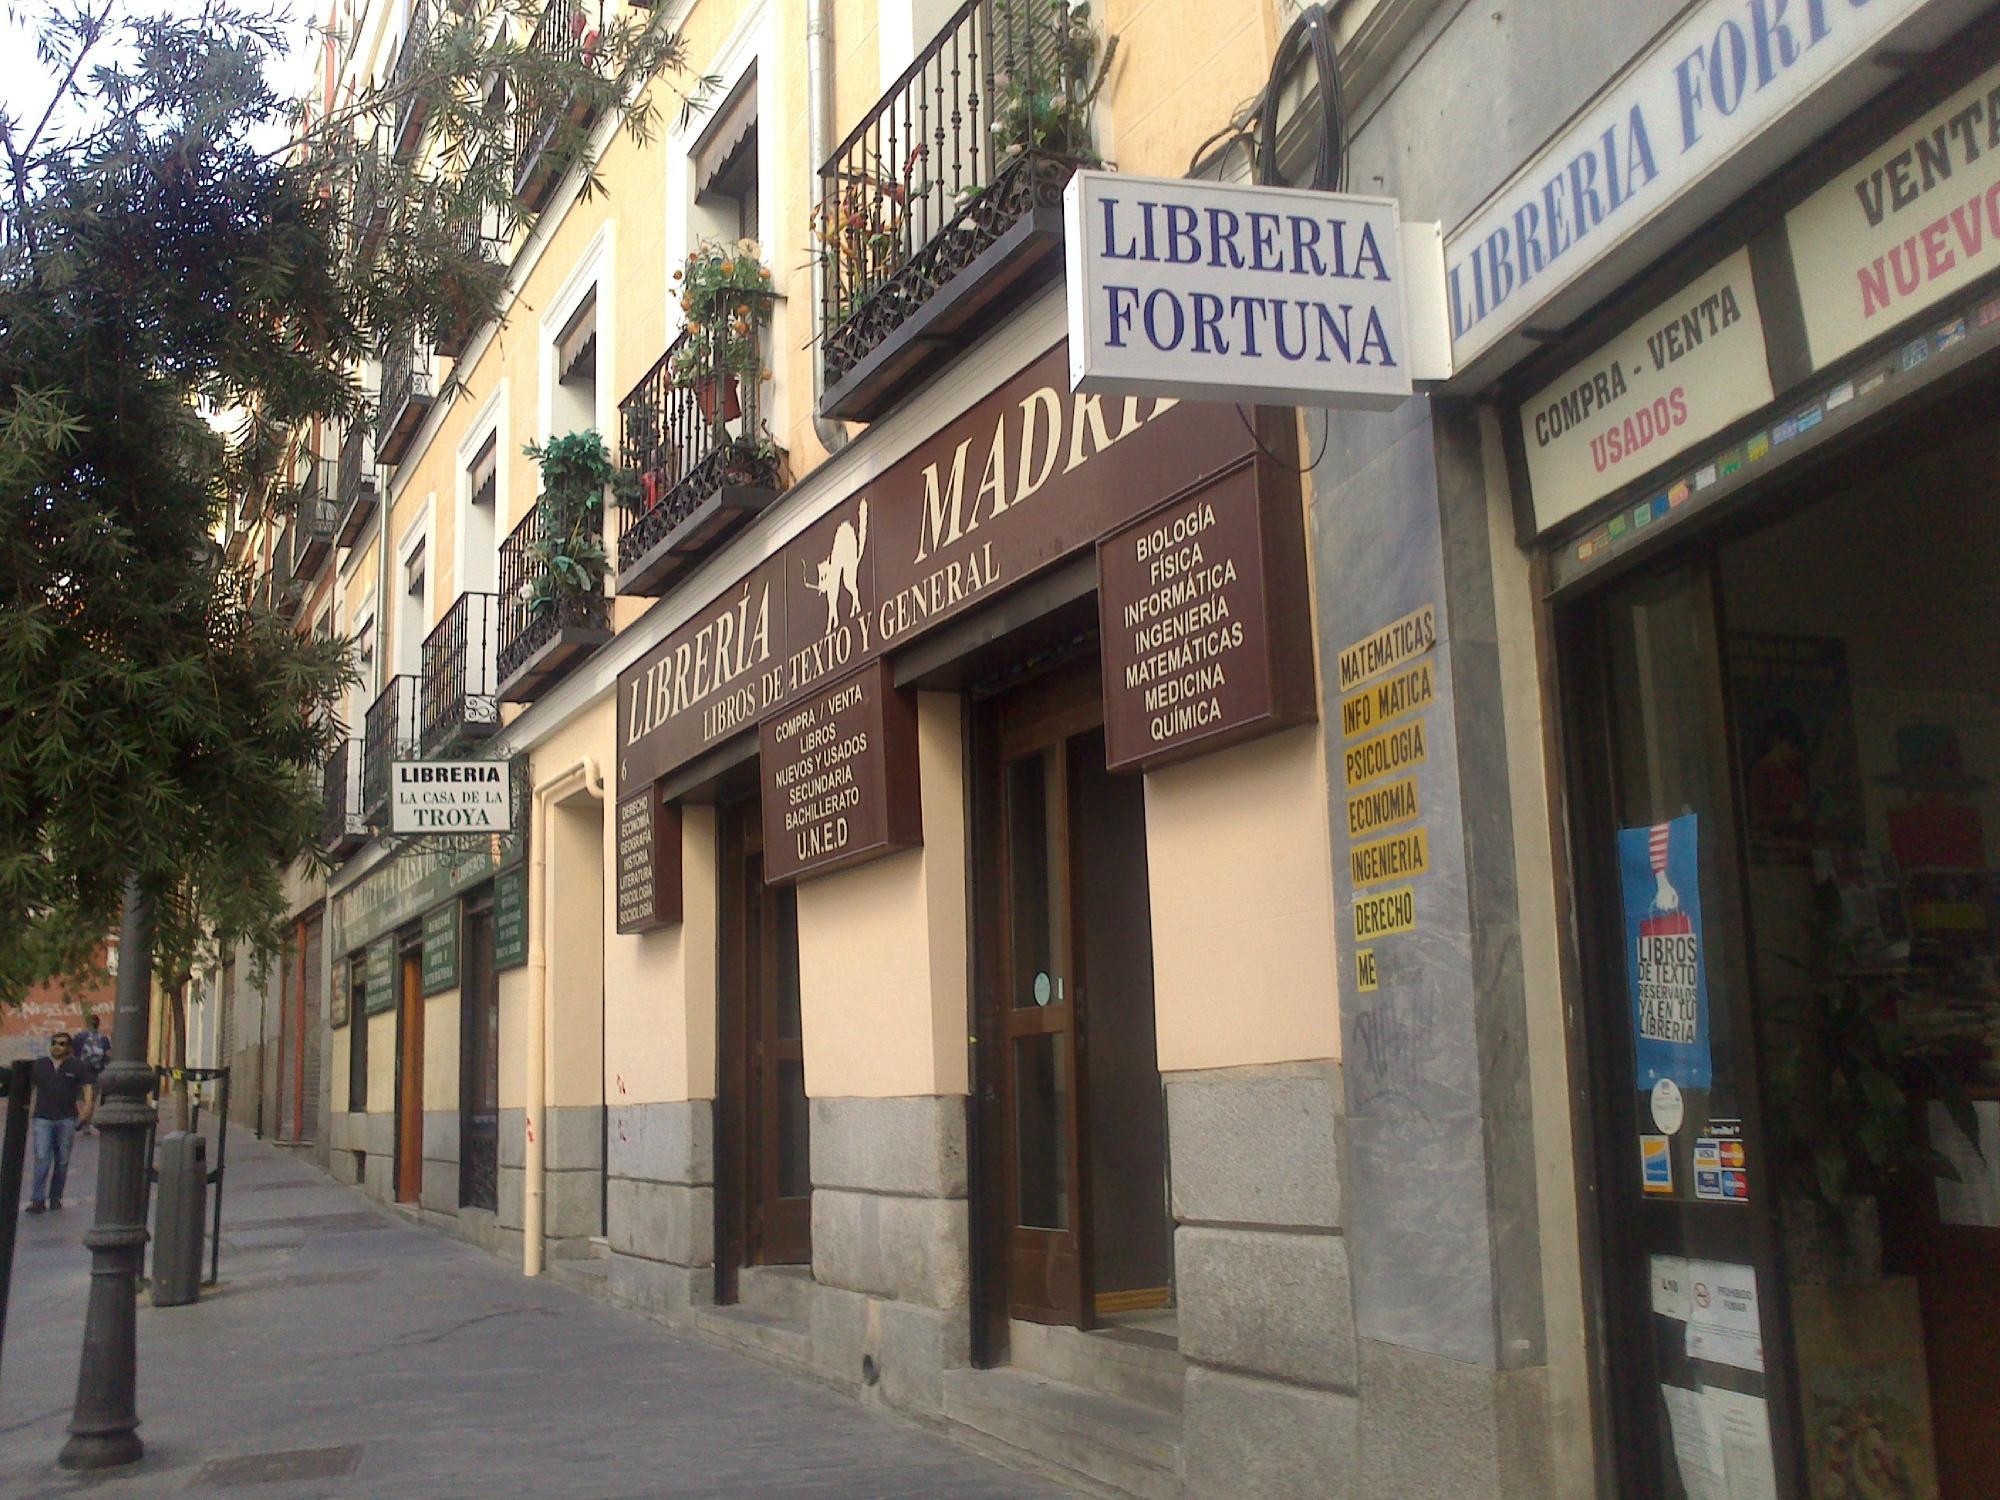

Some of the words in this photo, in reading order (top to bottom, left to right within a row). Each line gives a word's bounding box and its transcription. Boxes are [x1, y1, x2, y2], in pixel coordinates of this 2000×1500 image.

[1854, 86, 2000, 229] VENT
[1098, 197, 1391, 281] LIBRERIA
[1447, 103, 1659, 342] LIBRERIA
[1102, 285, 1397, 367] FORTUNA
[1535, 359, 1628, 447] COMPRA
[1646, 285, 1741, 372] VENTA
[1590, 386, 1688, 474] USADOS
[1136, 502, 1216, 562] BIOLOGÍA
[1151, 542, 1204, 586] FÍSICA
[1124, 558, 1237, 628] INFORMÁTICA
[703, 682, 756, 742] LIBROS
[761, 664, 784, 710] DE
[788, 626, 851, 691] TEXTO
[858, 611, 873, 653] Y
[880, 540, 1000, 641] GENERAL
[1135, 593, 1229, 655] INGENIERÍA
[627, 580, 771, 747] LIBRERÍA
[1126, 621, 1244, 689] MATEMÁTICAS
[1341, 611, 1434, 687] MATEMATICAS
[1144, 662, 1225, 713] MEDICINA
[1344, 693, 1371, 735] INFO
[1378, 665, 1432, 715] MATICA
[775, 708, 815, 743] COMPRA
[828, 683, 863, 716] VENTA
[1150, 696, 1222, 742] QUÍMICA
[775, 756, 813, 789] NUEVOS
[814, 753, 824, 771] Y
[824, 732, 867, 767] USADOS
[800, 722, 836, 754] LIBROS
[1346, 724, 1425, 784] PSICOLOGIA
[400, 791, 417, 804] LA
[423, 791, 456, 804] CASA
[462, 791, 479, 804] DE
[486, 791, 503, 804] LA
[401, 767, 500, 783] LIBRERIA
[789, 764, 853, 806] SECUNDARIA
[414, 808, 491, 827] TROYA
[622, 796, 648, 820] DERECHO
[785, 786, 859, 831] BACHILLERATO
[1349, 781, 1416, 833] ECONOMIA
[623, 848, 648, 872] HISTORIA
[797, 817, 848, 860] U.N.E.D
[1352, 835, 1423, 883] INGENIERIA
[620, 864, 652, 890] LITERATURA
[620, 880, 652, 907] PSICOLOGÍA
[620, 899, 653, 925] SOCIOLOGÍA
[1355, 892, 1413, 936] DERECHO
[1358, 952, 1376, 986] ME
[1639, 937, 1696, 963] LIBROS
[1638, 962, 1651, 982] DE
[1656, 963, 1696, 986] TEXTO
[1640, 1000, 1654, 1018] YA
[1658, 1001, 1673, 1019] EN
[1678, 1000, 1696, 1020] TU
[1640, 1017, 1695, 1043] LIBRERIA
